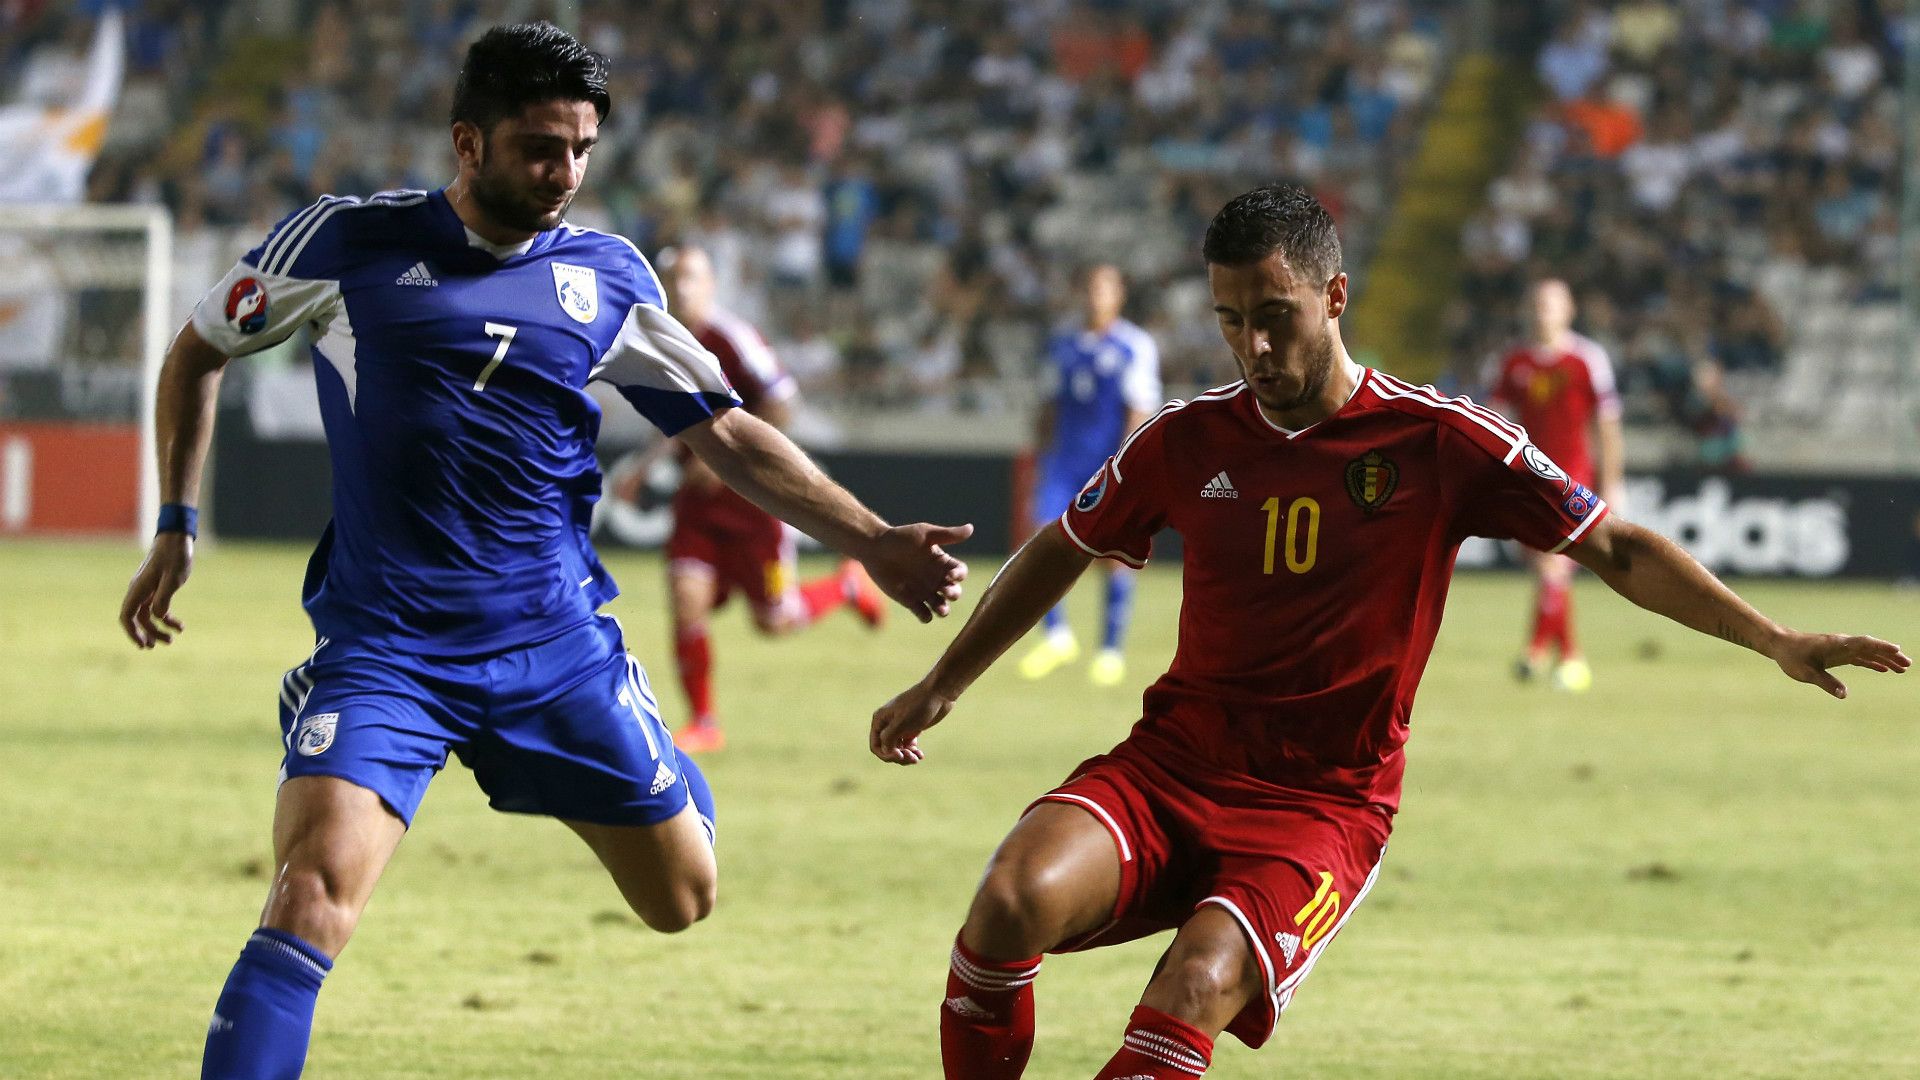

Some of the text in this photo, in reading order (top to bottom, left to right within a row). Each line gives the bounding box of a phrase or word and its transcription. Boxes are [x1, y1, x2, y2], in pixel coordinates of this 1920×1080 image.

[396, 276, 439, 287] adidas
[473, 322, 517, 392] 7
[1200, 486, 1239, 499] adidas
[1260, 496, 1320, 575] 10
[617, 684, 659, 761] 7
[1293, 871, 1341, 951] 10
